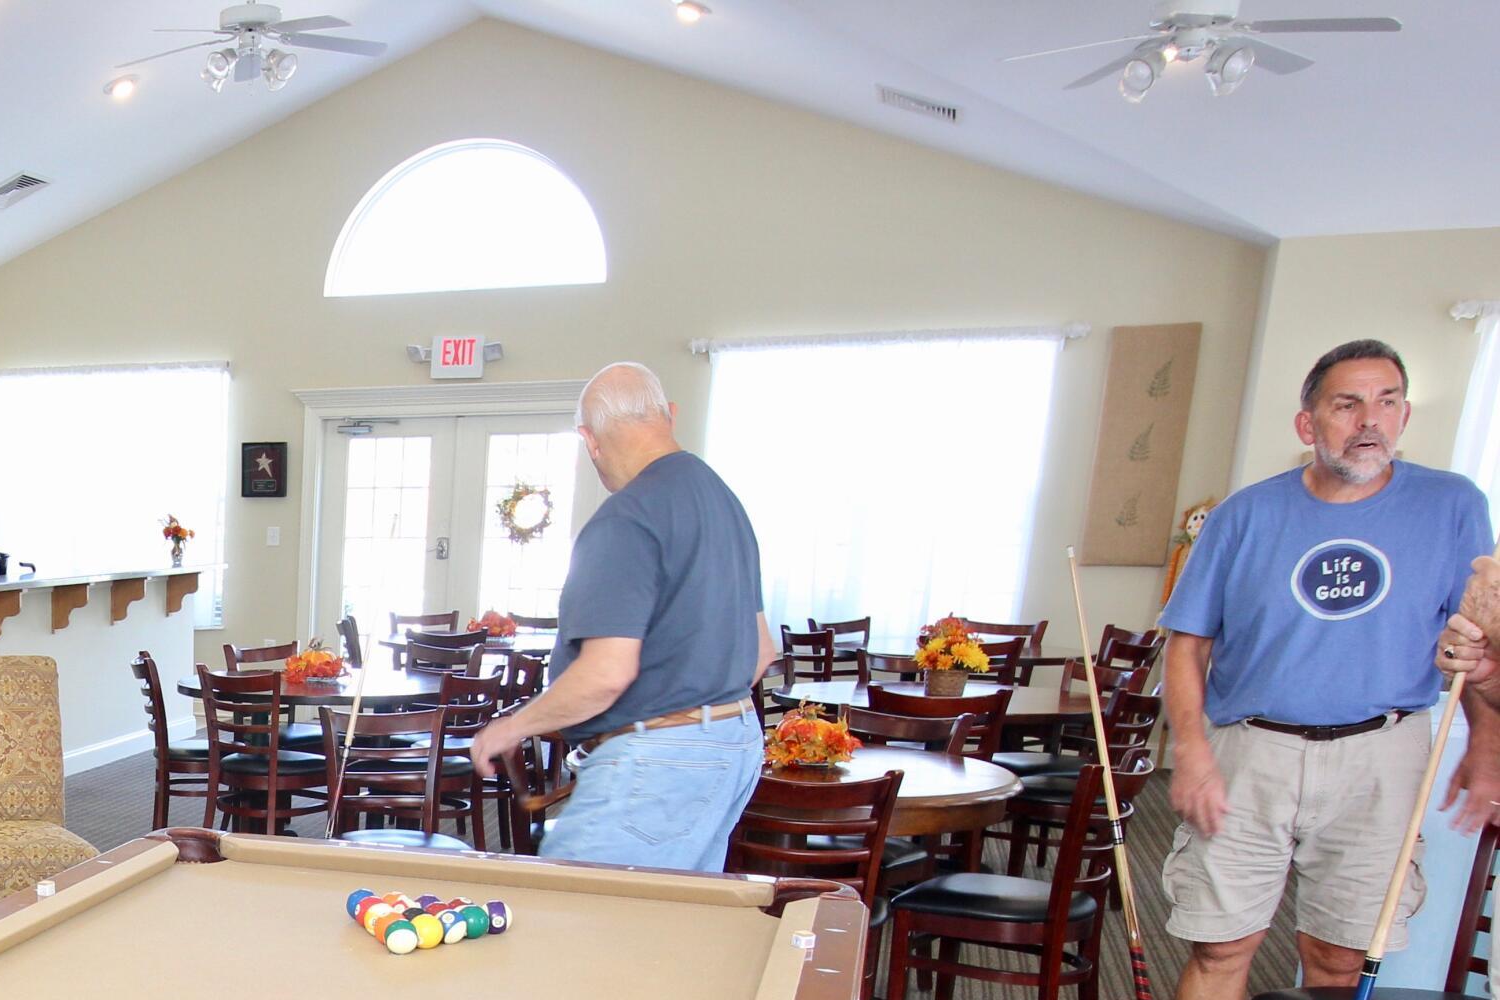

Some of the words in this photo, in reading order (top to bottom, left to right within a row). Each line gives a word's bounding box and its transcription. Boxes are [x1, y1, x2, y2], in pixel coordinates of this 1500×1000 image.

[442, 339, 476, 365] EXIT
[1321, 556, 1362, 575] Life
[1336, 573, 1349, 585] is
[1315, 581, 1366, 600] Good
